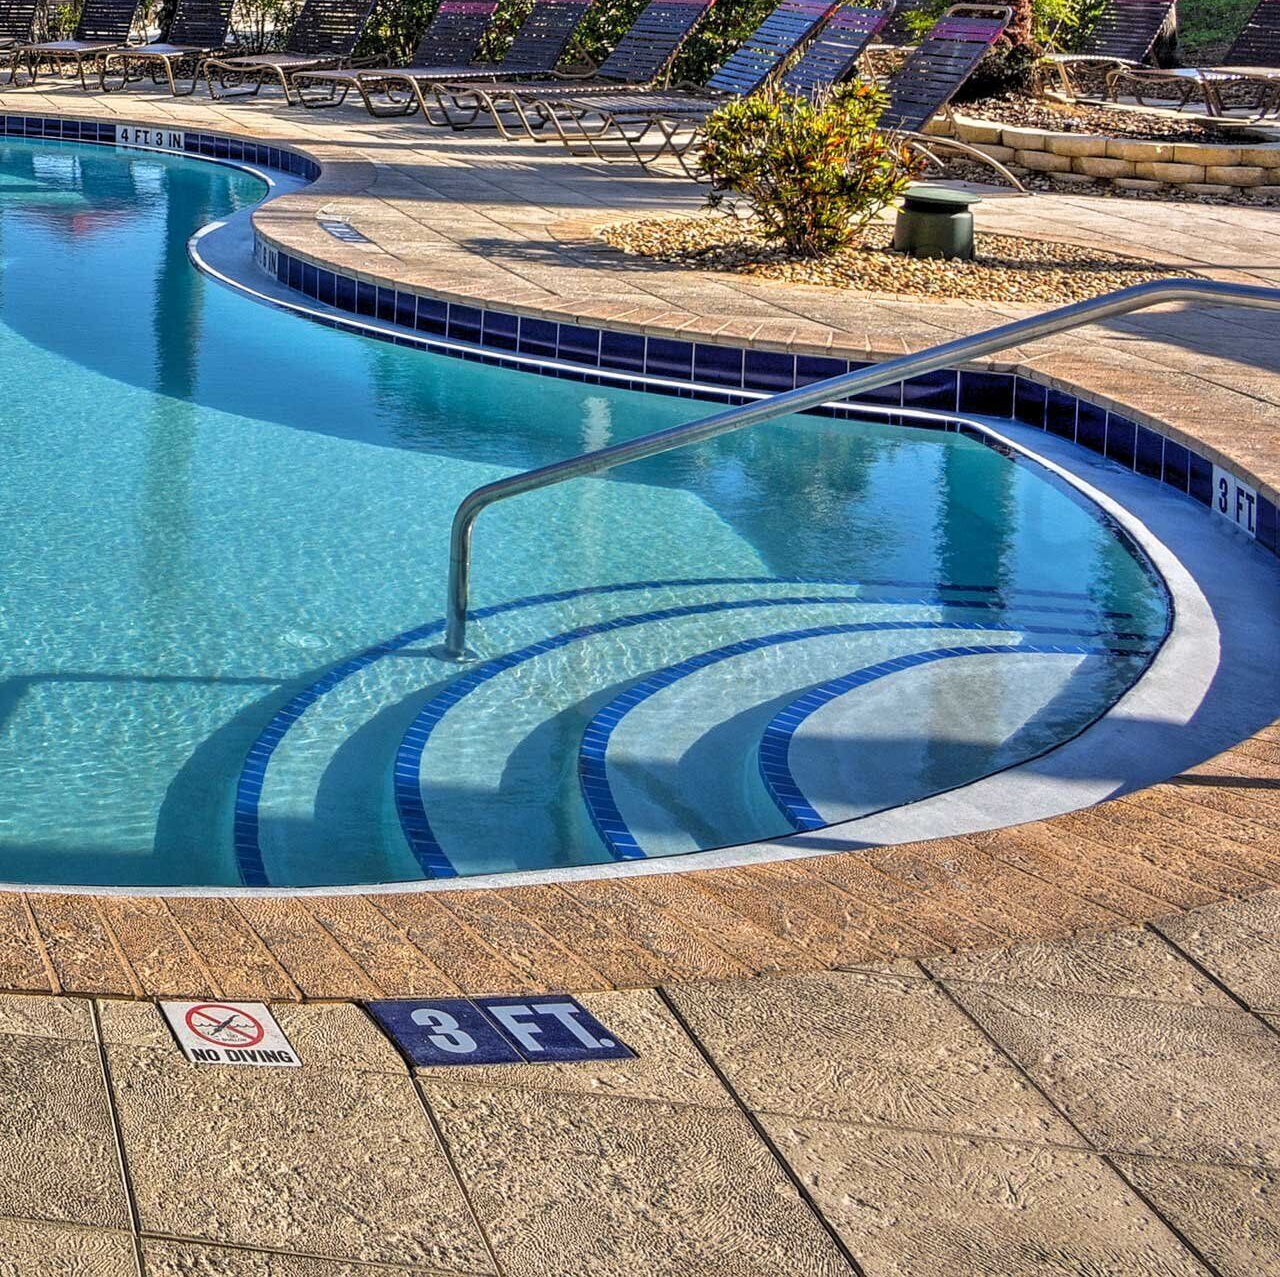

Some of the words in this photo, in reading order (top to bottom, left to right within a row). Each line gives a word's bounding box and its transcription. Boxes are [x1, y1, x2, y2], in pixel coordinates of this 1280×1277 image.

[121, 128, 129, 143] 4
[135, 129, 150, 145] FT.
[156, 132, 163, 146] 3
[168, 133, 184, 149] IN.
[1218, 477, 1228, 514] 3
[1236, 486, 1255, 534] FT.
[410, 1008, 478, 1053] 3
[487, 1003, 616, 1052] FT.
[190, 1048, 220, 1062] NO
[224, 1049, 295, 1063] DIVING
